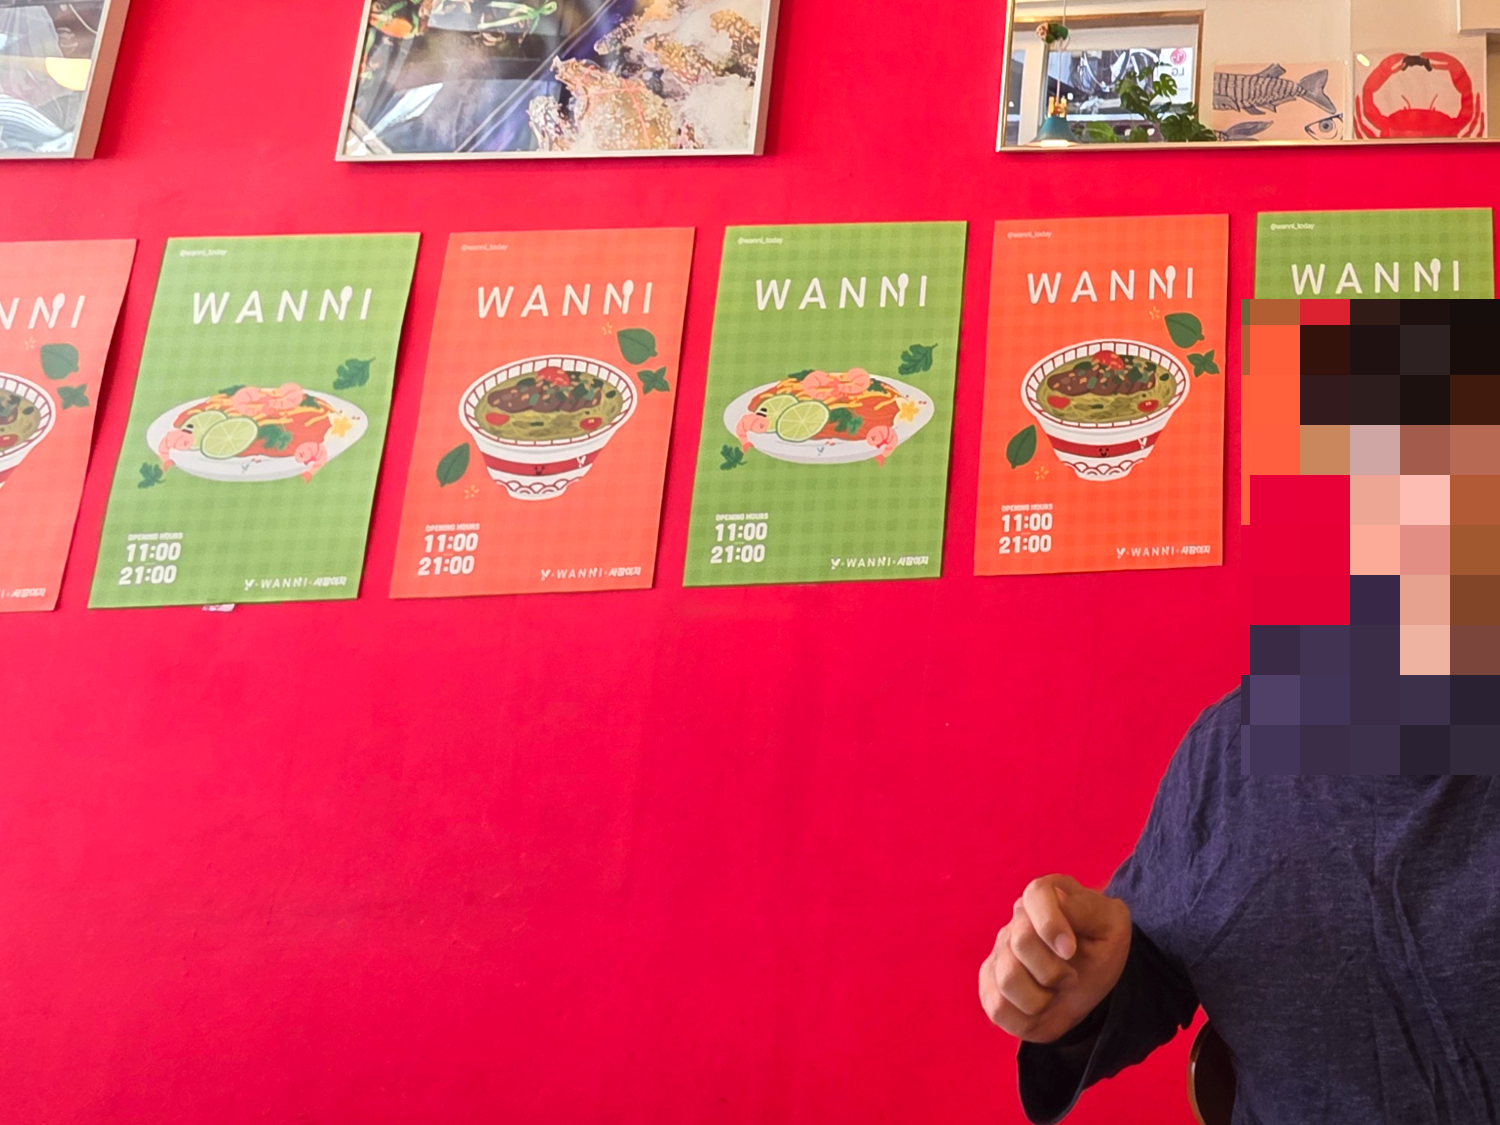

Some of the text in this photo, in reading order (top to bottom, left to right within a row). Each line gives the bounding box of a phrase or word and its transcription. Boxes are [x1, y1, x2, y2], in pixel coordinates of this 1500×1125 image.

[1027, 265, 1194, 305] WANNI
[1291, 257, 1460, 296] WANNI
[477, 279, 653, 319] WANNI
[755, 272, 928, 311] WANNI
[0, 292, 86, 331] NNI
[192, 285, 373, 325] WANNI
[715, 521, 768, 542] 11:00
[1001, 512, 1053, 533] 11:00
[126, 541, 182, 563] 11:00
[424, 532, 479, 553] 11:00
[998, 534, 1052, 555] 21:00
[1131, 545, 1175, 557] WANNI
[710, 543, 766, 564] 21:00
[846, 555, 891, 568] WANNI
[117, 564, 177, 586] 21:00
[417, 555, 475, 576] 21:00
[556, 566, 603, 579] WANNI
[260, 576, 308, 589] WANNI
